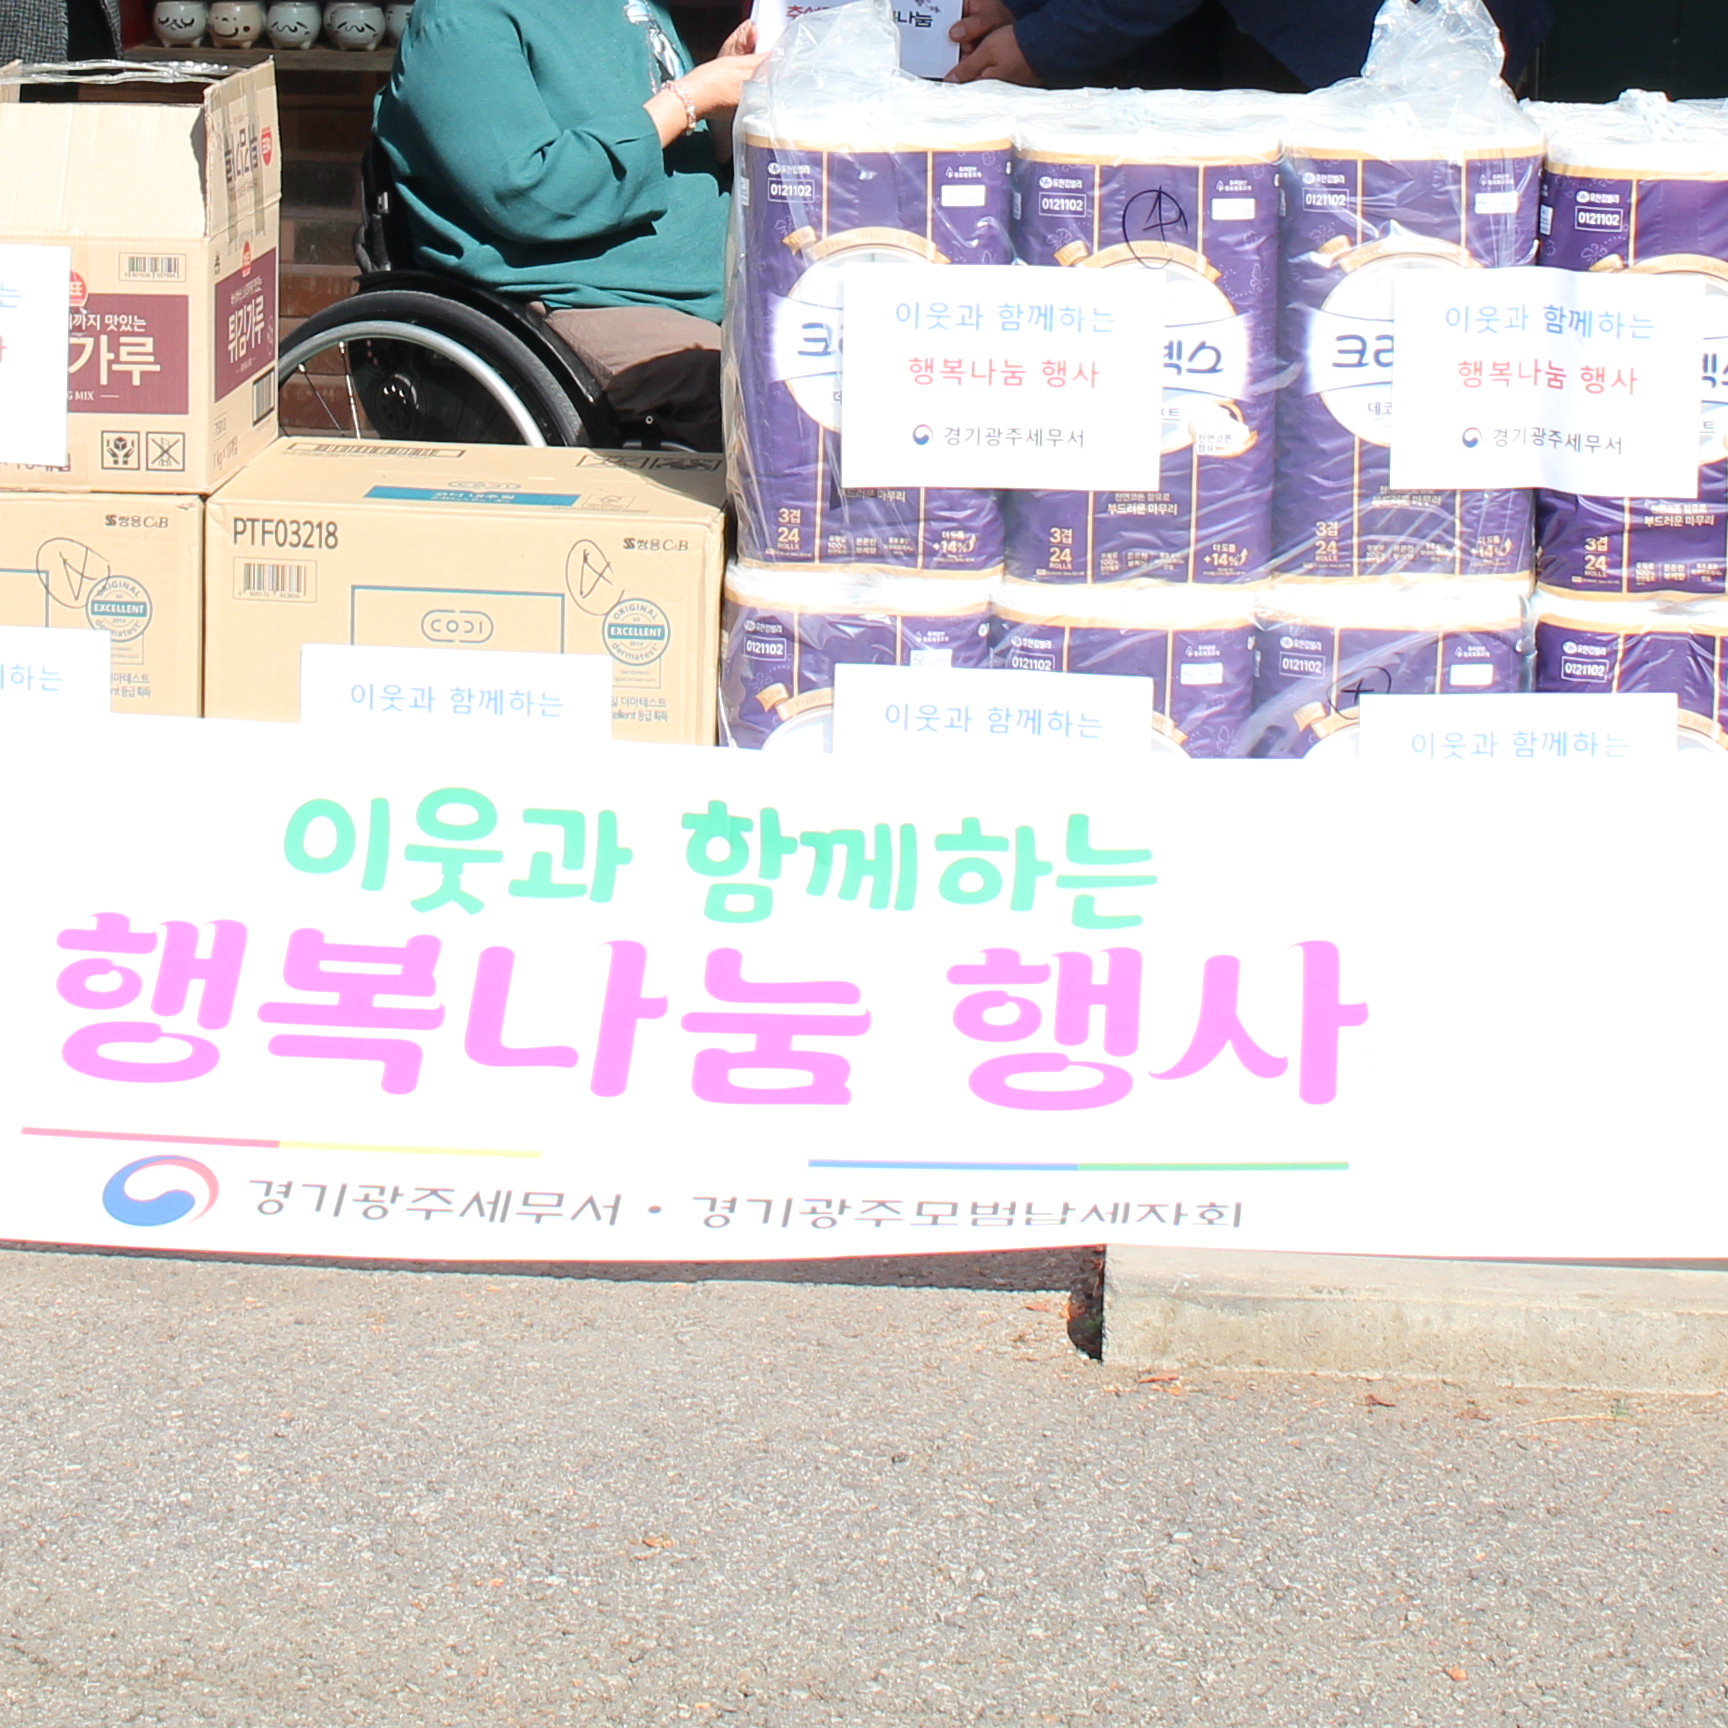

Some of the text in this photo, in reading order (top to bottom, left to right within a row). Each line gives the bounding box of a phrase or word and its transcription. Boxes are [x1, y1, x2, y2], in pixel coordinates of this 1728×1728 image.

[893, 10, 934, 29] 나눔
[770, 184, 812, 197] 0121102
[1042, 198, 1084, 211] 0121102
[1305, 193, 1347, 206] 0121102
[1577, 212, 1620, 226] 0121102
[69, 313, 148, 333] 까지 맛있는
[895, 300, 1117, 334] 이웃과 함께하는
[1444, 304, 1656, 340] 이웃과 함께하는
[227, 294, 265, 364] 튀김가루
[907, 356, 1101, 390] 행복나눔 행사
[1457, 360, 1639, 396] 행복나눔 행사
[74, 390, 95, 401] MIX
[943, 424, 1086, 450] 경기광주세무서
[1491, 427, 1624, 456] 경기광주세무서
[778, 508, 801, 525] 3겹
[1107, 503, 1178, 516] 부드러운 마무리
[1315, 520, 1338, 537] 3겹
[1644, 515, 1715, 527] 부드러운 마무리
[232, 516, 339, 550] PTF03218
[777, 526, 800, 543] 24
[1049, 527, 1072, 545] 3겹
[1315, 539, 1338, 555] 24
[1584, 535, 1608, 552] 3겹
[1049, 546, 1072, 563] 24
[1584, 554, 1608, 570] 24
[93, 603, 145, 614] EXCELLENT
[613, 603, 659, 621] ORIGINAL
[610, 626, 662, 638] EXCELLENT
[612, 642, 659, 661] dermatest
[746, 641, 784, 655] 0121102
[1012, 656, 1052, 671] 0121102
[1282, 658, 1323, 673] 0121102
[1565, 663, 1606, 677] 0121102
[110, 673, 150, 684] 마테스트
[349, 682, 565, 718] 이웃과 함께하는
[620, 696, 668, 708] 더마테스트
[884, 702, 1104, 739] 이웃과 함께하는
[1411, 731, 1630, 760] 이웃과 함께하는
[282, 784, 1159, 931] 이웃과 함께하는
[55, 909, 1370, 1114] 행복나눔 행사
[248, 1179, 622, 1225] 경기광주세무서
